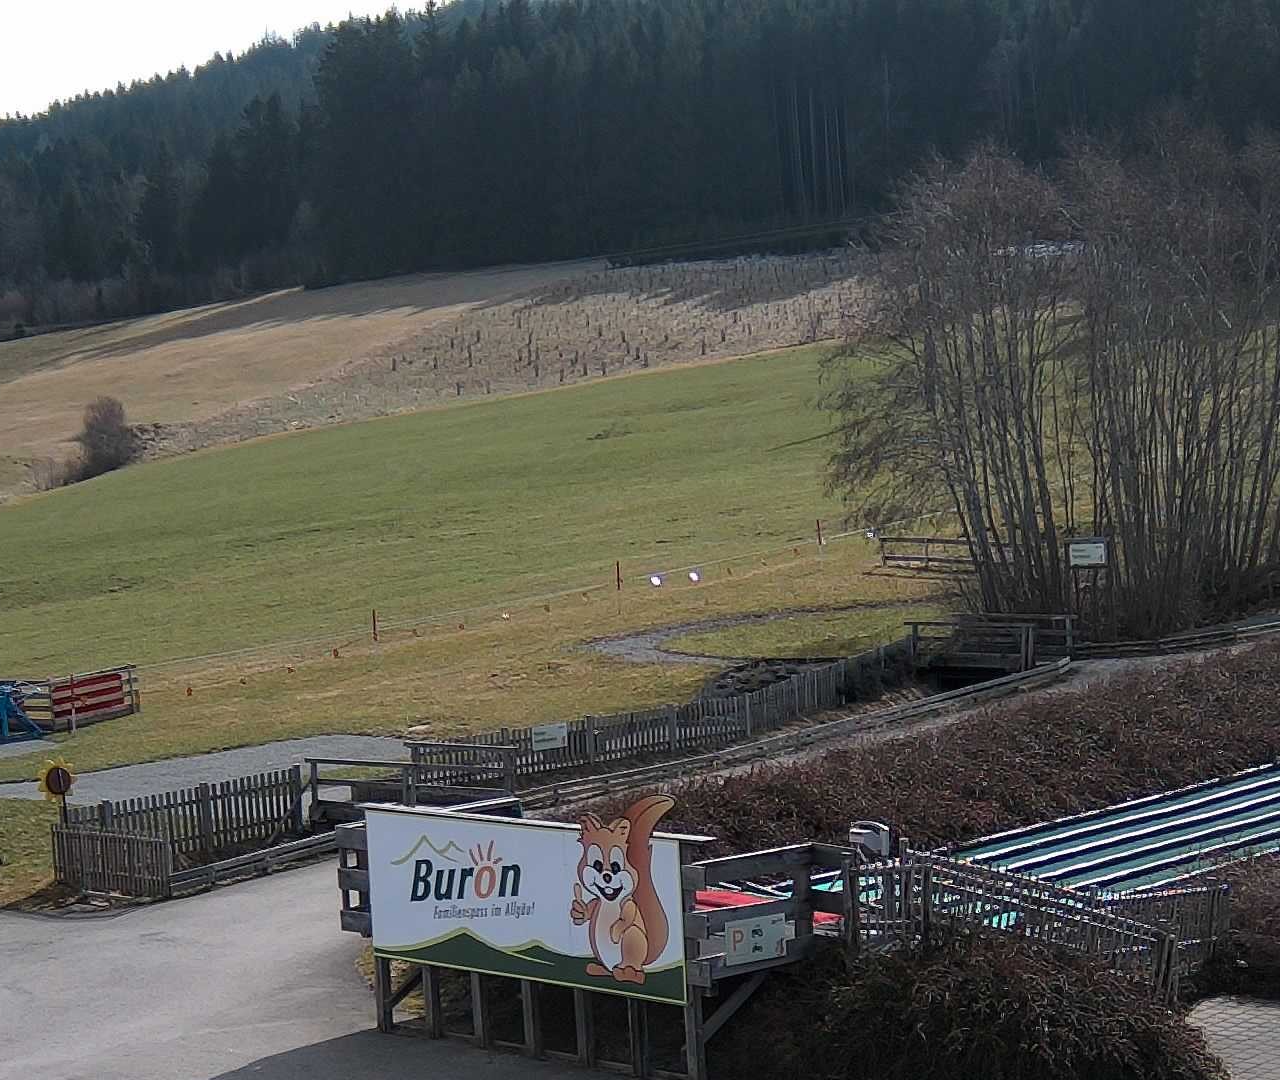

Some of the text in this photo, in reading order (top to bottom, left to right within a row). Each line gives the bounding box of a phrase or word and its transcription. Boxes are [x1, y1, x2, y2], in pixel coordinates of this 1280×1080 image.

[410, 858, 521, 902] Buron
[491, 903, 502, 917] im
[732, 929, 745, 952] P
